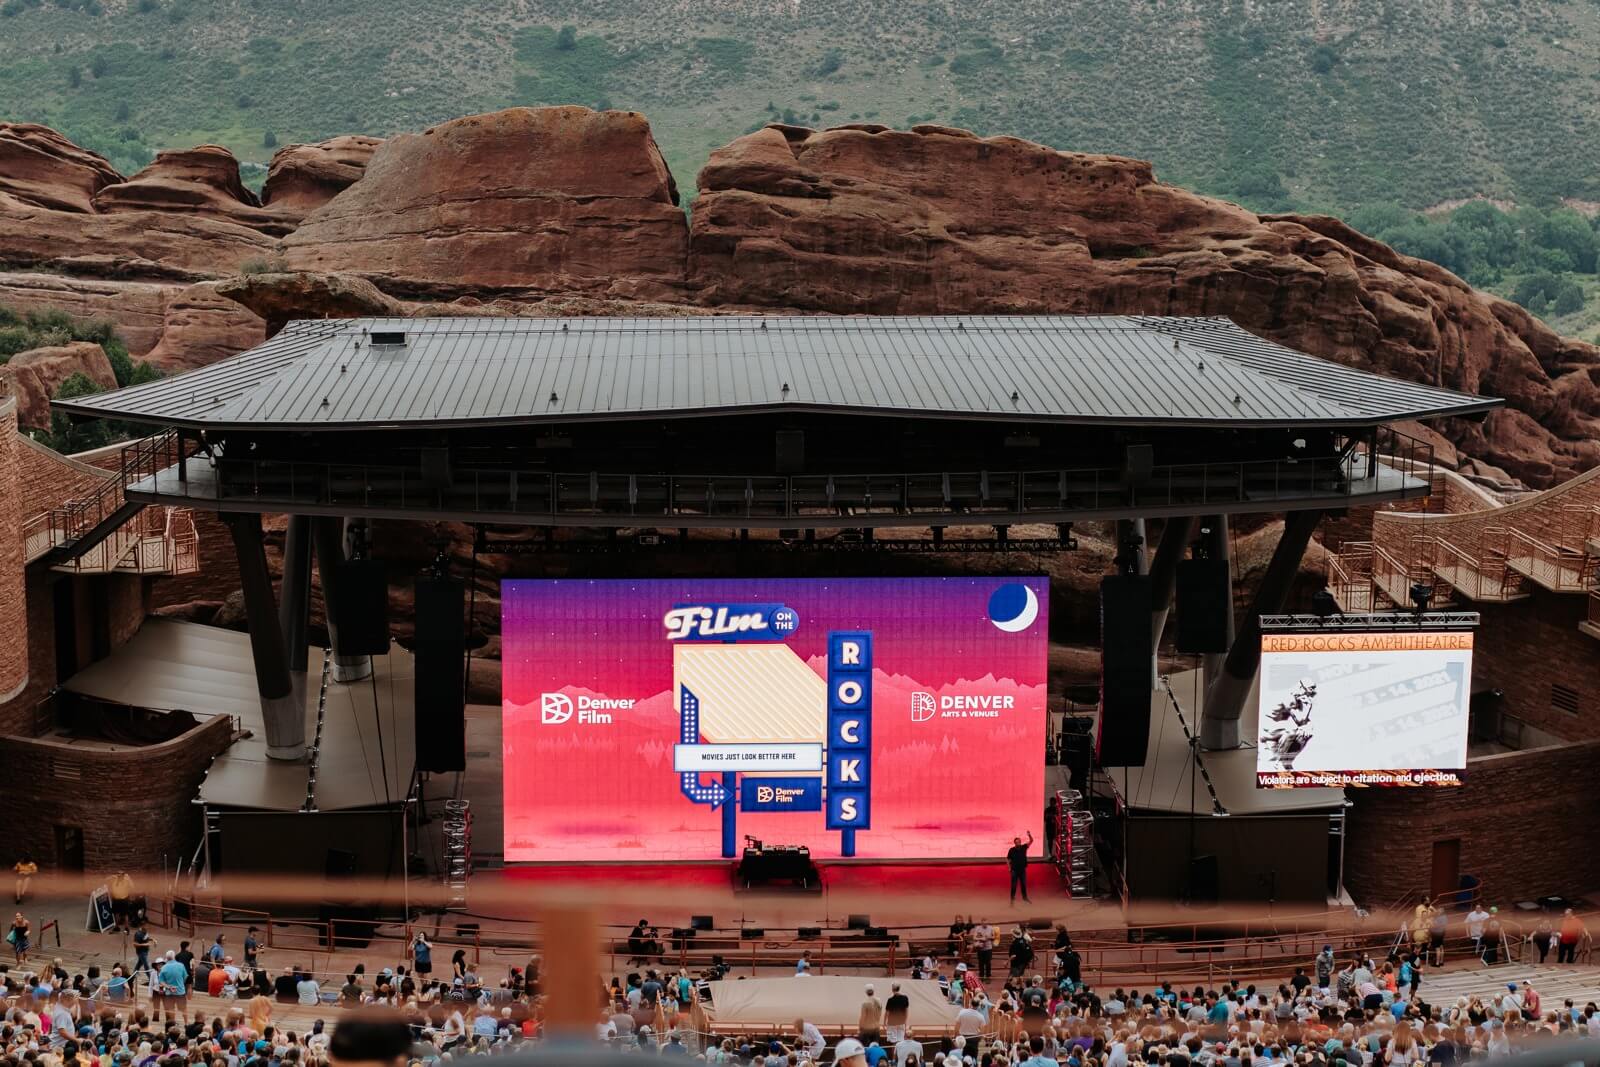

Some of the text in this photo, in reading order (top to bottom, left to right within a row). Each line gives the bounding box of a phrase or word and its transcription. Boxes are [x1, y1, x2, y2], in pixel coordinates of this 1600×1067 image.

[664, 606, 768, 640] Film
[776, 612, 792, 620] ON
[775, 622, 793, 630] THE
[1271, 635, 1465, 651] RED ROCKS AMPHITHEATRE
[578, 695, 635, 710] Denver
[941, 695, 1014, 709] DENVER
[578, 710, 612, 724] Film
[941, 710, 999, 718] ARTS & VENUES
[838, 641, 862, 822] ROCKS
[781, 752, 796, 760] HERE
[1259, 772, 1459, 786] Violators are subject to citation and ejection.
[775, 787, 804, 795] Denver
[775, 794, 793, 803] Film
